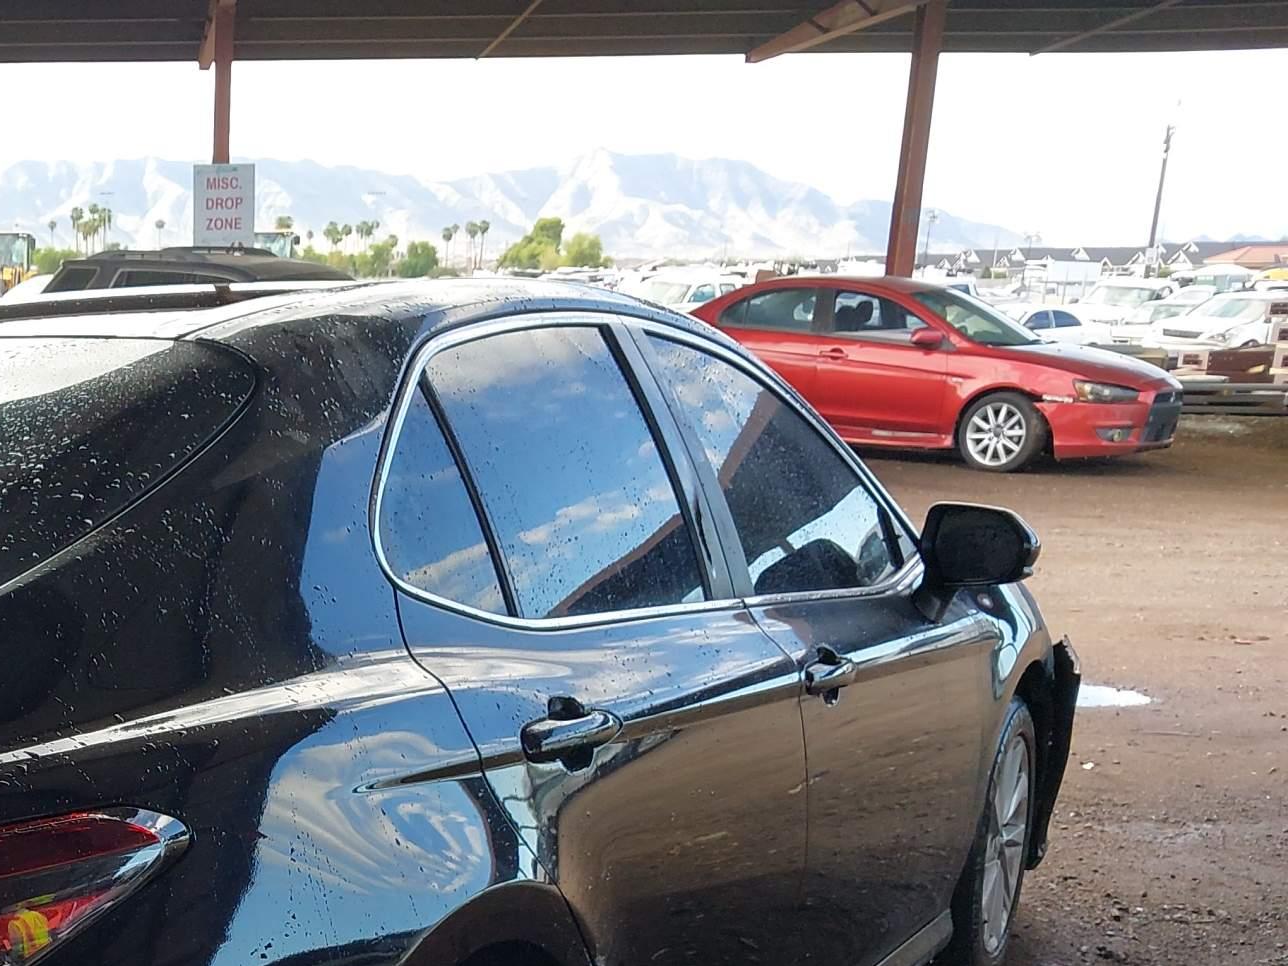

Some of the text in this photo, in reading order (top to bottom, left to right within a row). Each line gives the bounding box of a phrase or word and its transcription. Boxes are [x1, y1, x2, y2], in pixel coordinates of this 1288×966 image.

[206, 176, 243, 190] MISC.
[206, 197, 244, 210] DROP
[206, 217, 242, 231] ZONE
